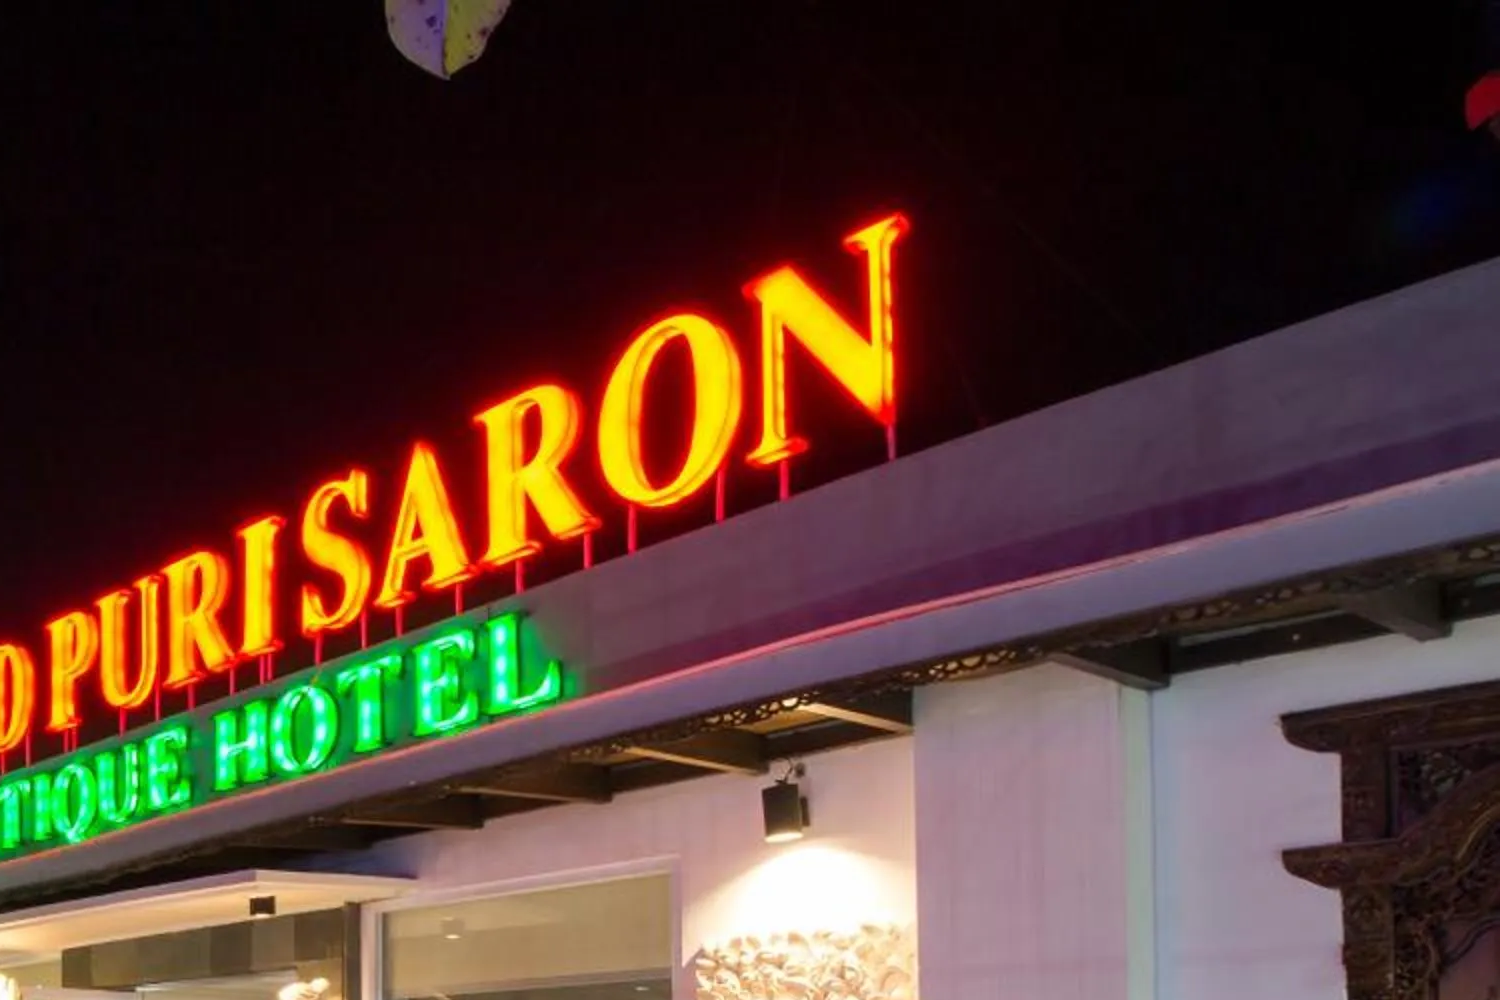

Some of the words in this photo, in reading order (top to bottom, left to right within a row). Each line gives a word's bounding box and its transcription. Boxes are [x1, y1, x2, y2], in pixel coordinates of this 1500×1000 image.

[47, 515, 286, 732] PURI
[301, 211, 910, 632] SARON
[213, 612, 563, 789] HOTEL
